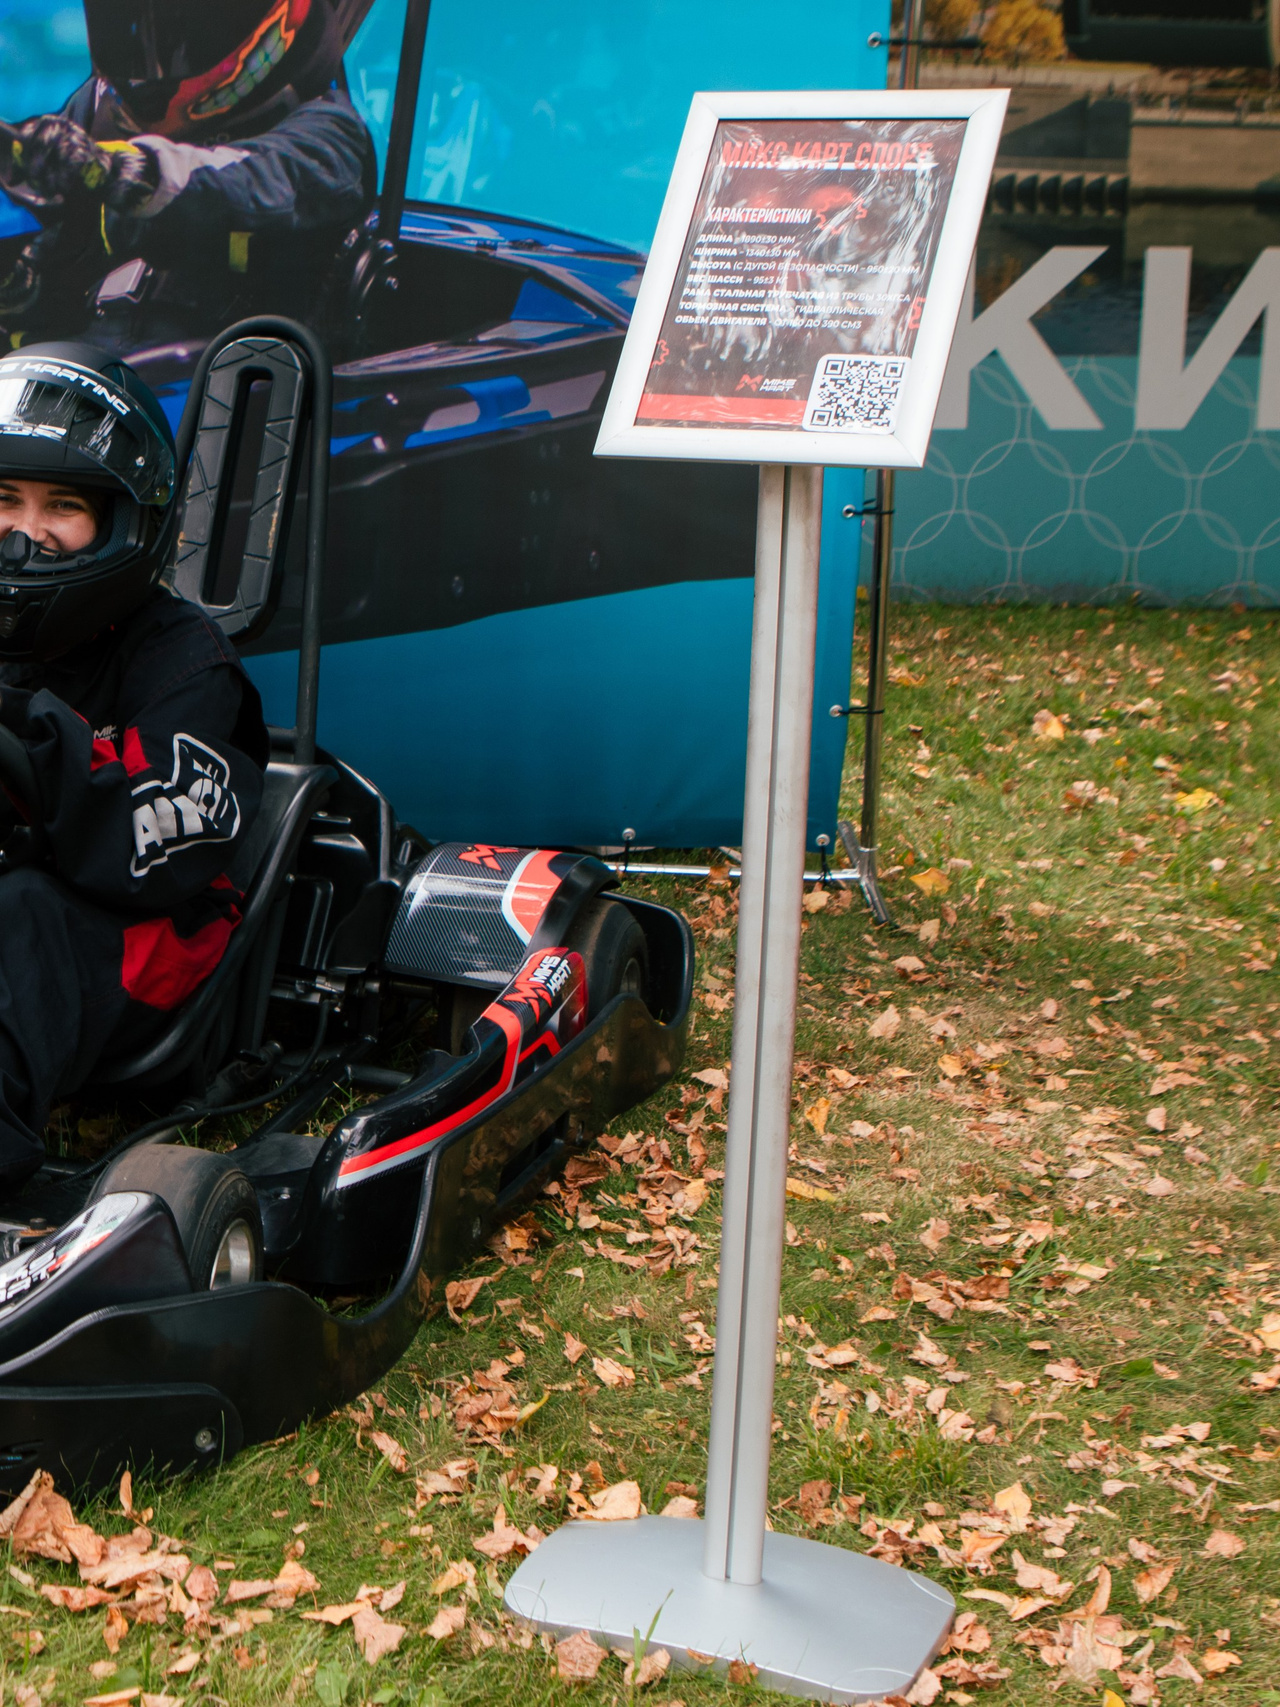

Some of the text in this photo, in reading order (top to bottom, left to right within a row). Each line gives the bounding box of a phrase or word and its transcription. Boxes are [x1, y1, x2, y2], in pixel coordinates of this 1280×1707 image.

[794, 142, 853, 169] КАРТ
[706, 206, 813, 224] ХАРАКТЕРИСТИКИ
[697, 234, 733, 244] ДЛИНА
[778, 235, 796, 244] ММ
[693, 247, 737, 257] ШИРИНА
[782, 249, 800, 258] ММ
[743, 261, 776, 272] ДУГОЙ
[707, 275, 744, 284] ШАССИ
[713, 289, 765, 298] СТАЛЬНАЯ
[710, 316, 767, 326] ДВИГАТЕЛЯ
[804, 319, 821, 328] ДО
[21, 362, 131, 416] KARTING
